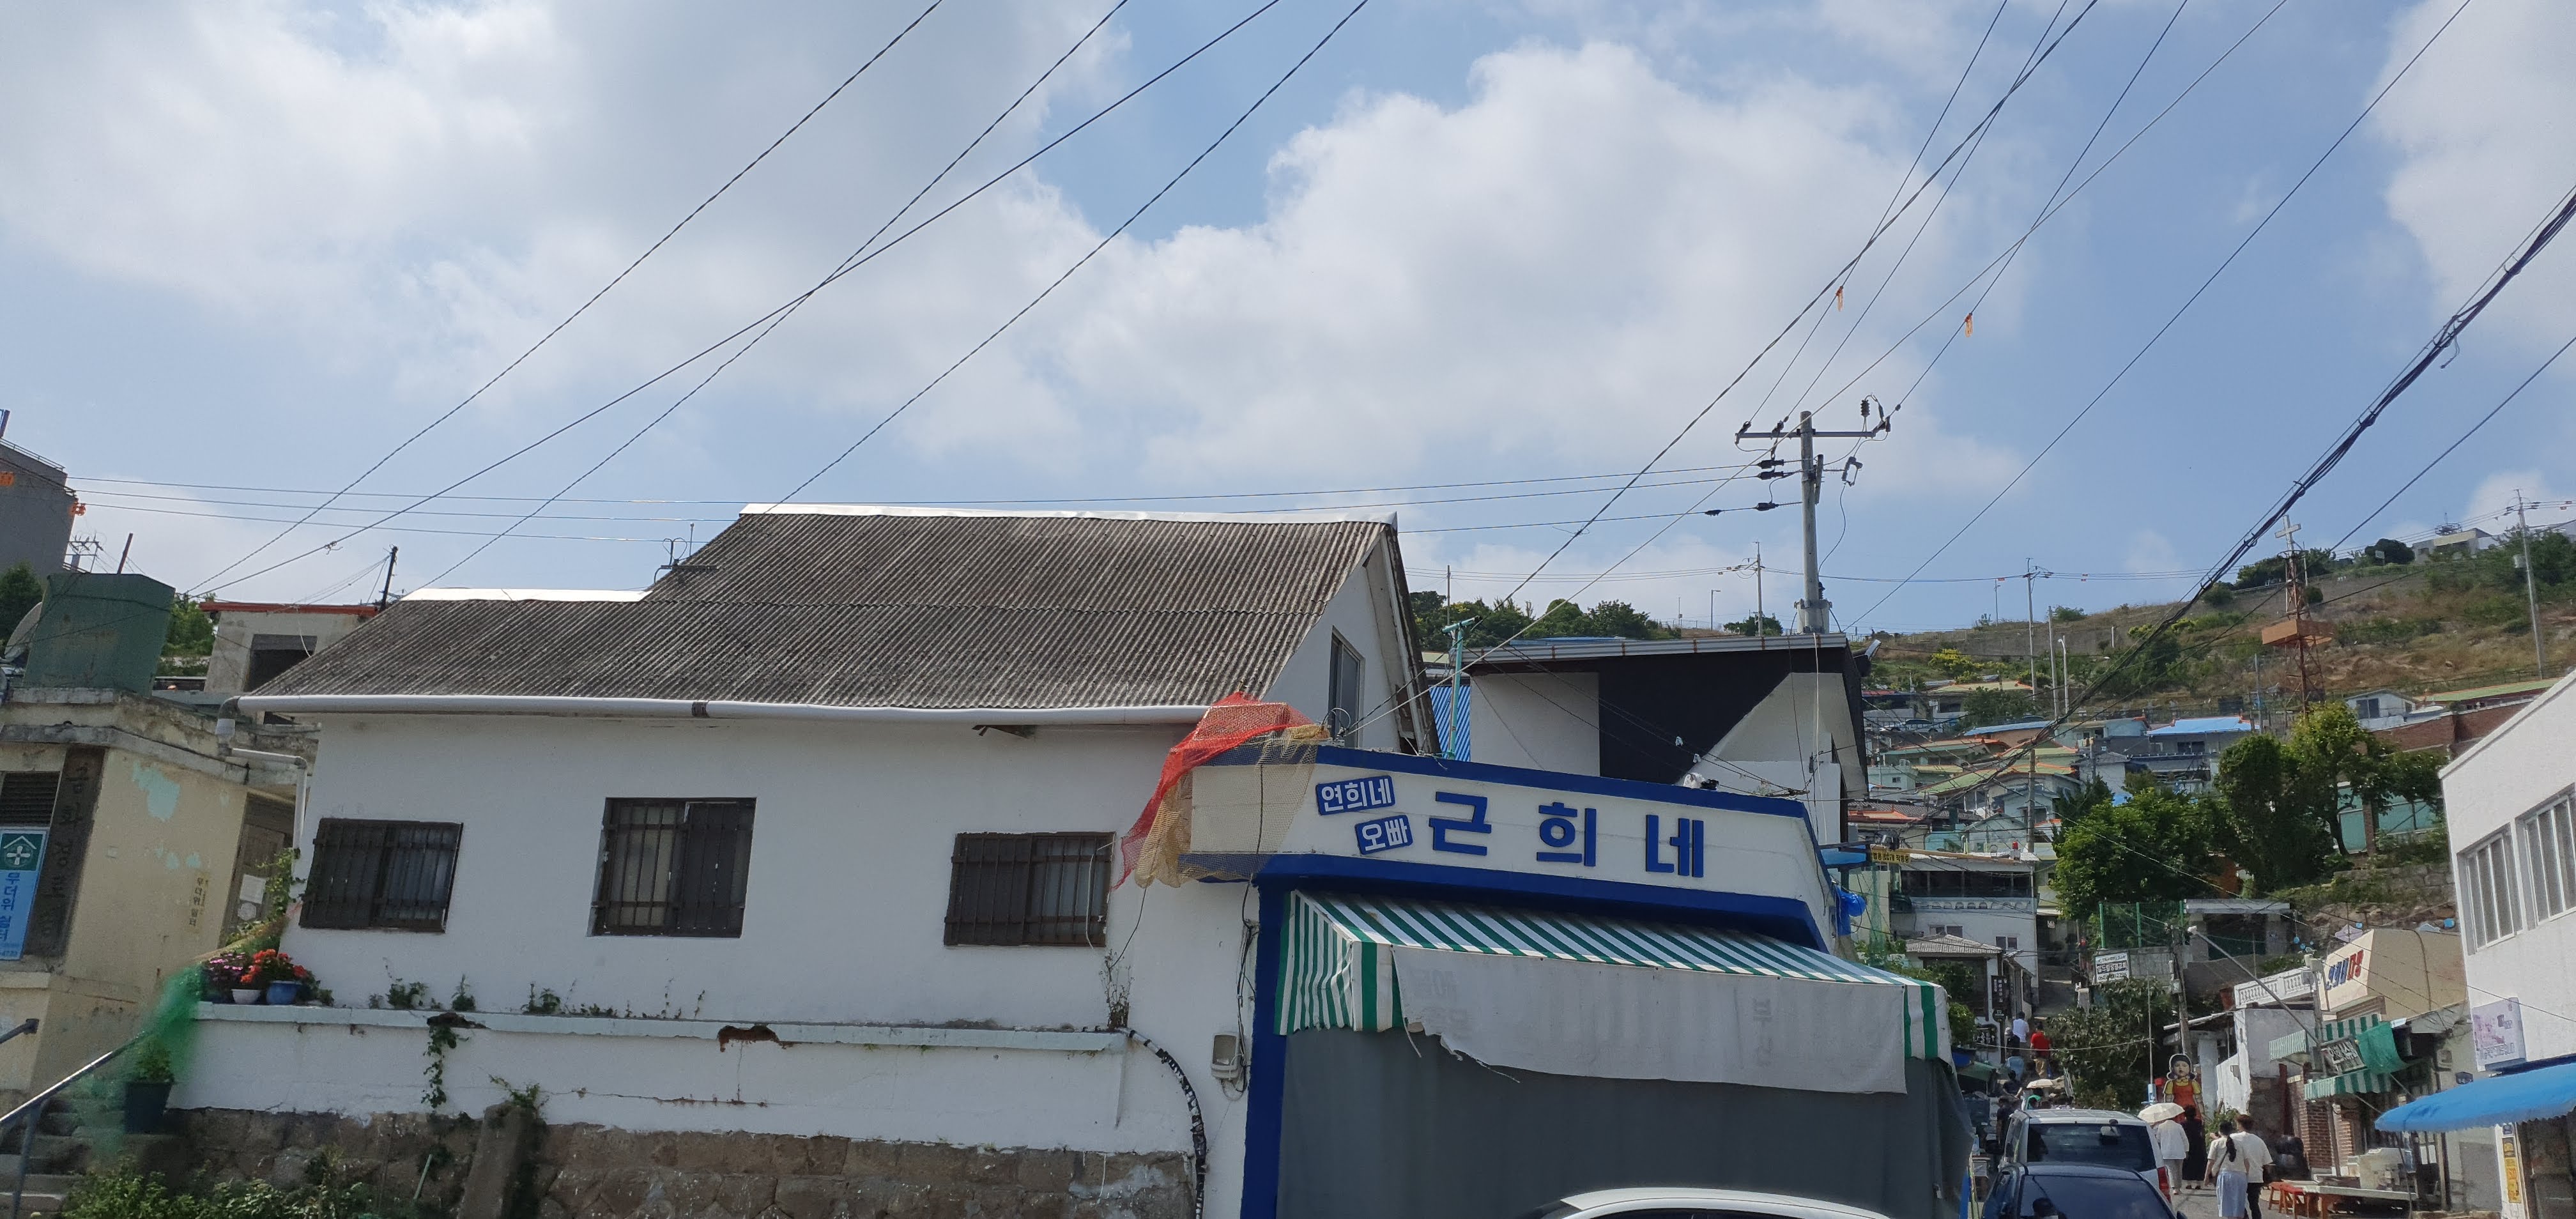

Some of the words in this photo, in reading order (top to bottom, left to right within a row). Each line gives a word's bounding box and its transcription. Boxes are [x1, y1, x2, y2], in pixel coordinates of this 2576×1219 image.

[1321, 778, 1392, 812] 연희네
[1361, 818, 1408, 851] 오빠
[1429, 791, 1704, 878] 근희네
[1, 872, 20, 910] 무더위
